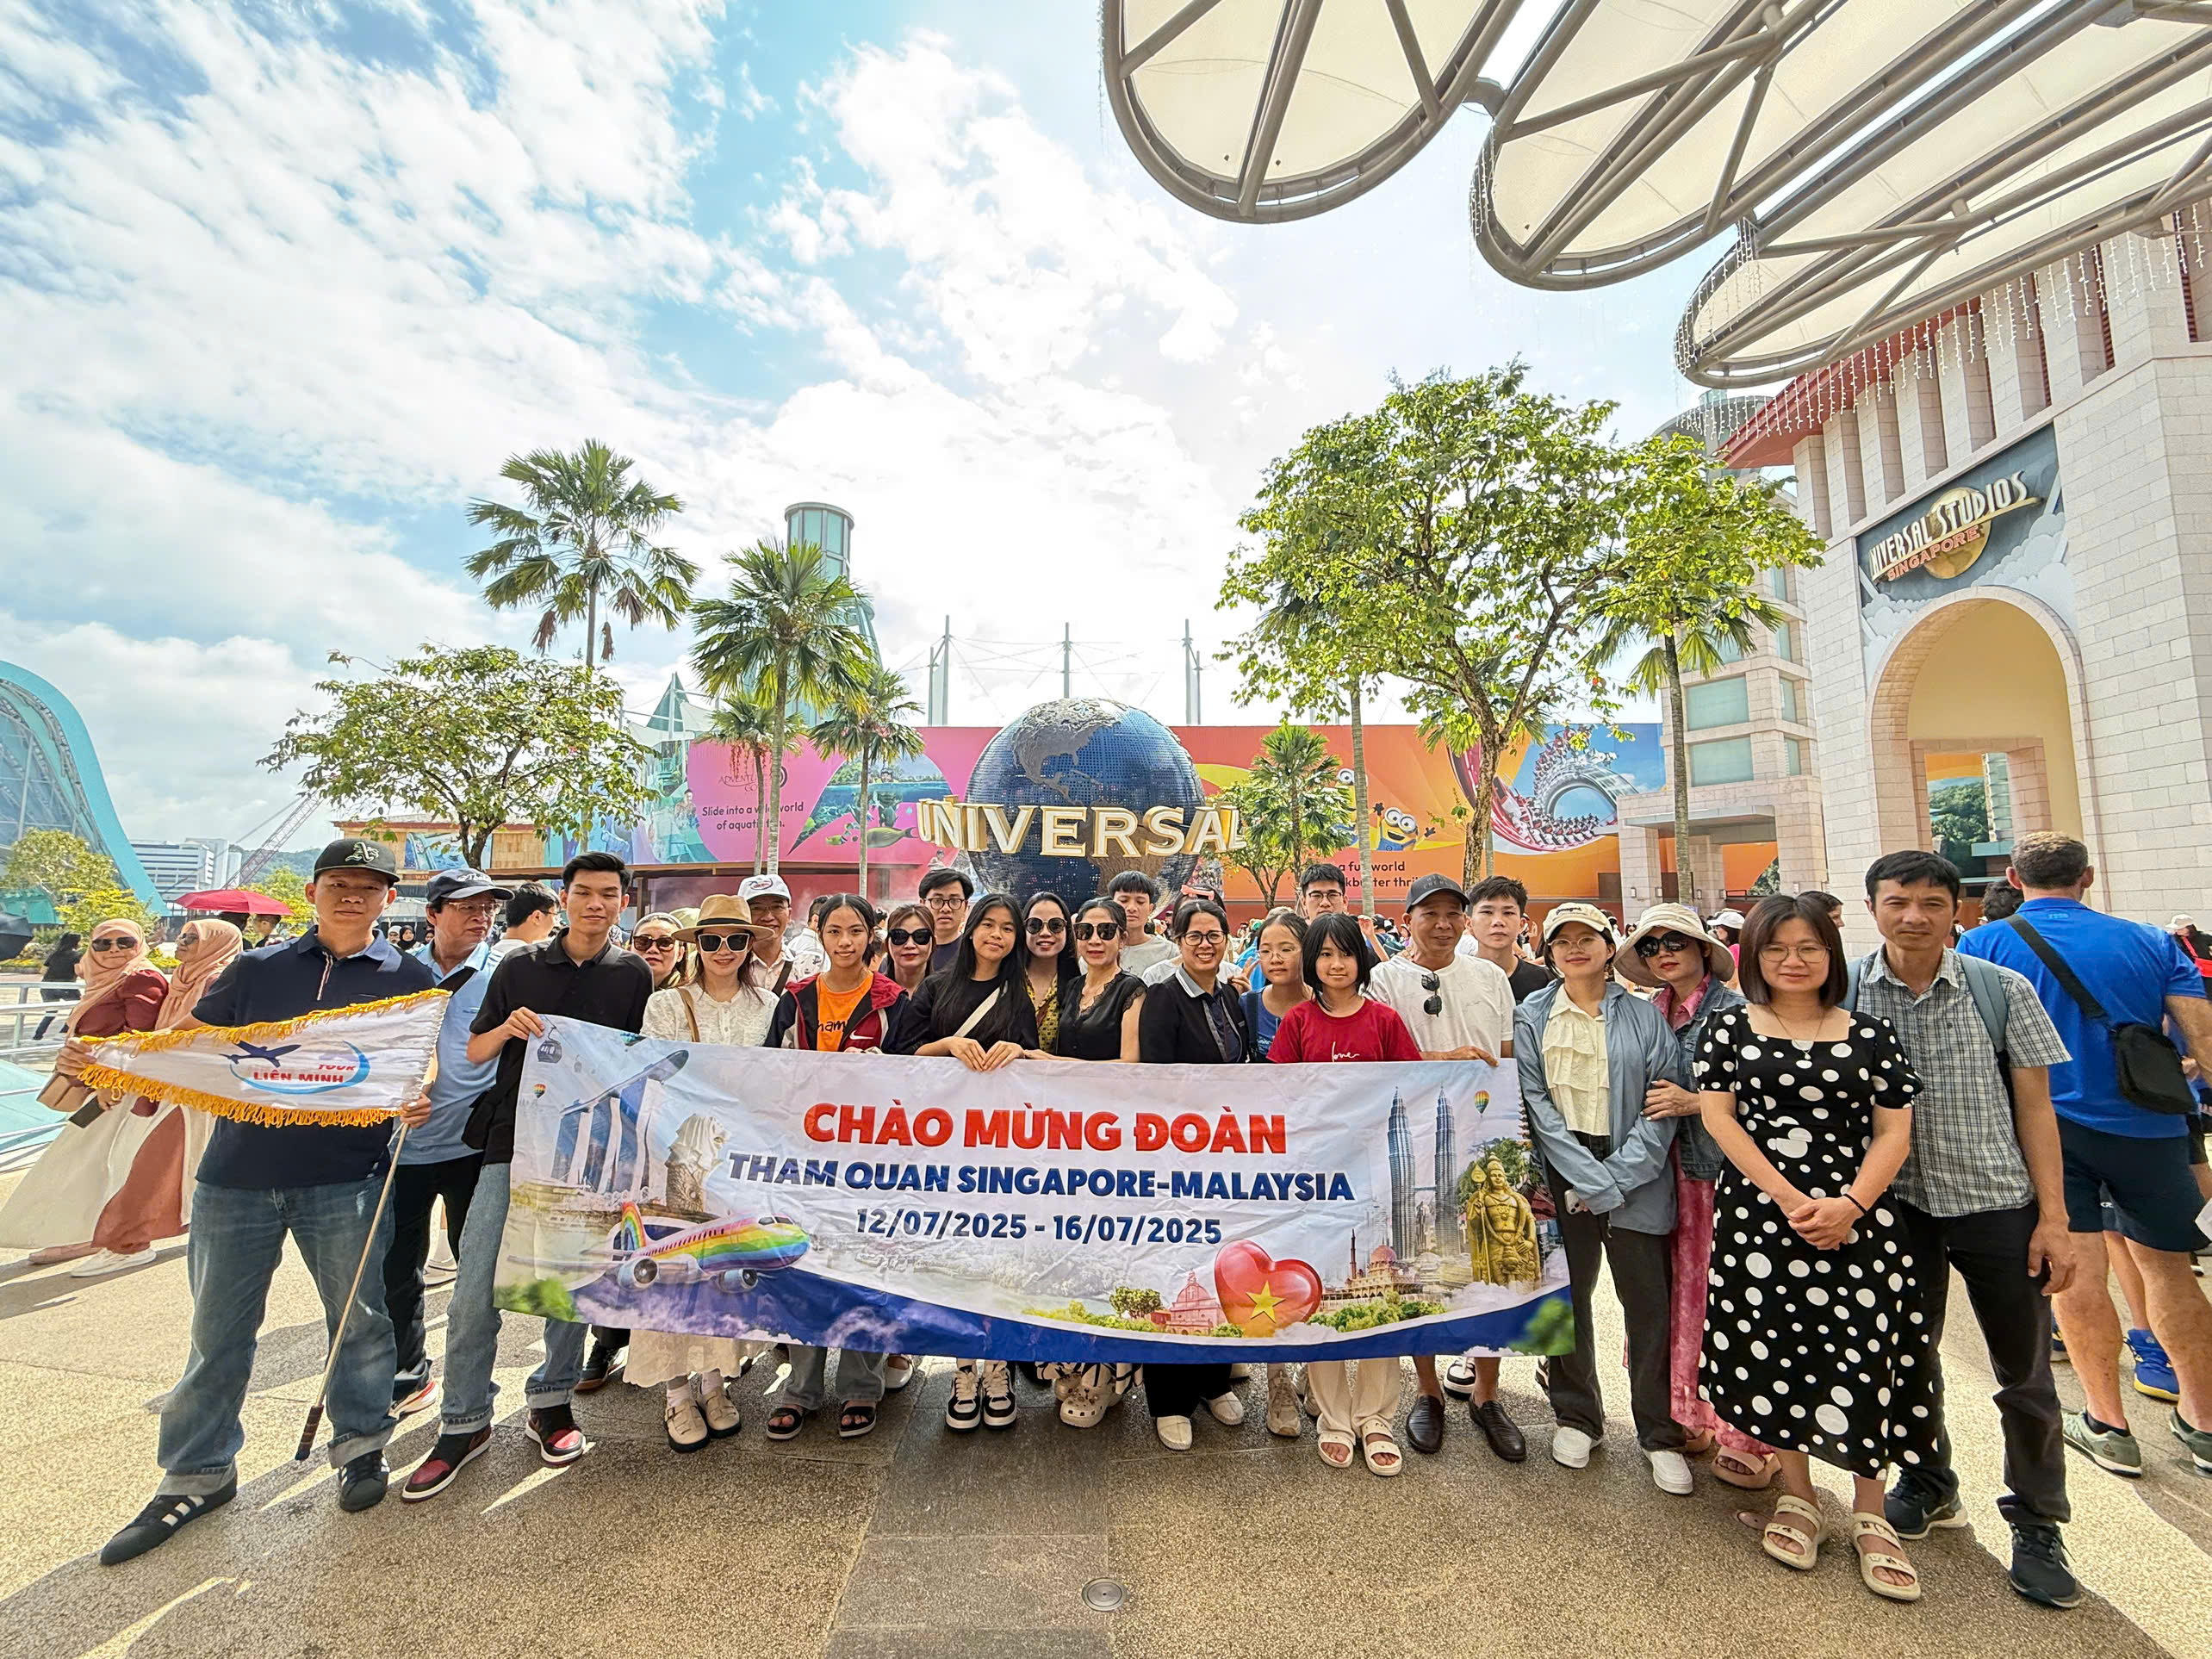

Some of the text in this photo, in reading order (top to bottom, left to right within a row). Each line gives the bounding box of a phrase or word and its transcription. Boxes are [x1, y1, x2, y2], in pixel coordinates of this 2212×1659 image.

[1936, 470, 2028, 536] STUDIOS
[1886, 525, 1981, 581] SINGAPORE
[702, 806, 724, 817] Slide
[726, 805, 743, 816] into
[717, 820, 727, 830] of
[729, 819, 760, 831] aquati
[916, 798, 1247, 857] UNIVERSAL
[1348, 861, 1364, 872] fu
[1371, 861, 1406, 872] world
[253, 1069, 344, 1083] LIÊN MINH
[804, 1099, 1286, 1153] CHÀO MỪNG ĐOÀN
[730, 1153, 1355, 1201] THAM QUAN SINGAPORE-MALAYSIA
[857, 1208, 1027, 1240] 12/07/2025
[1053, 1215, 1222, 1246] 16/07/2025
